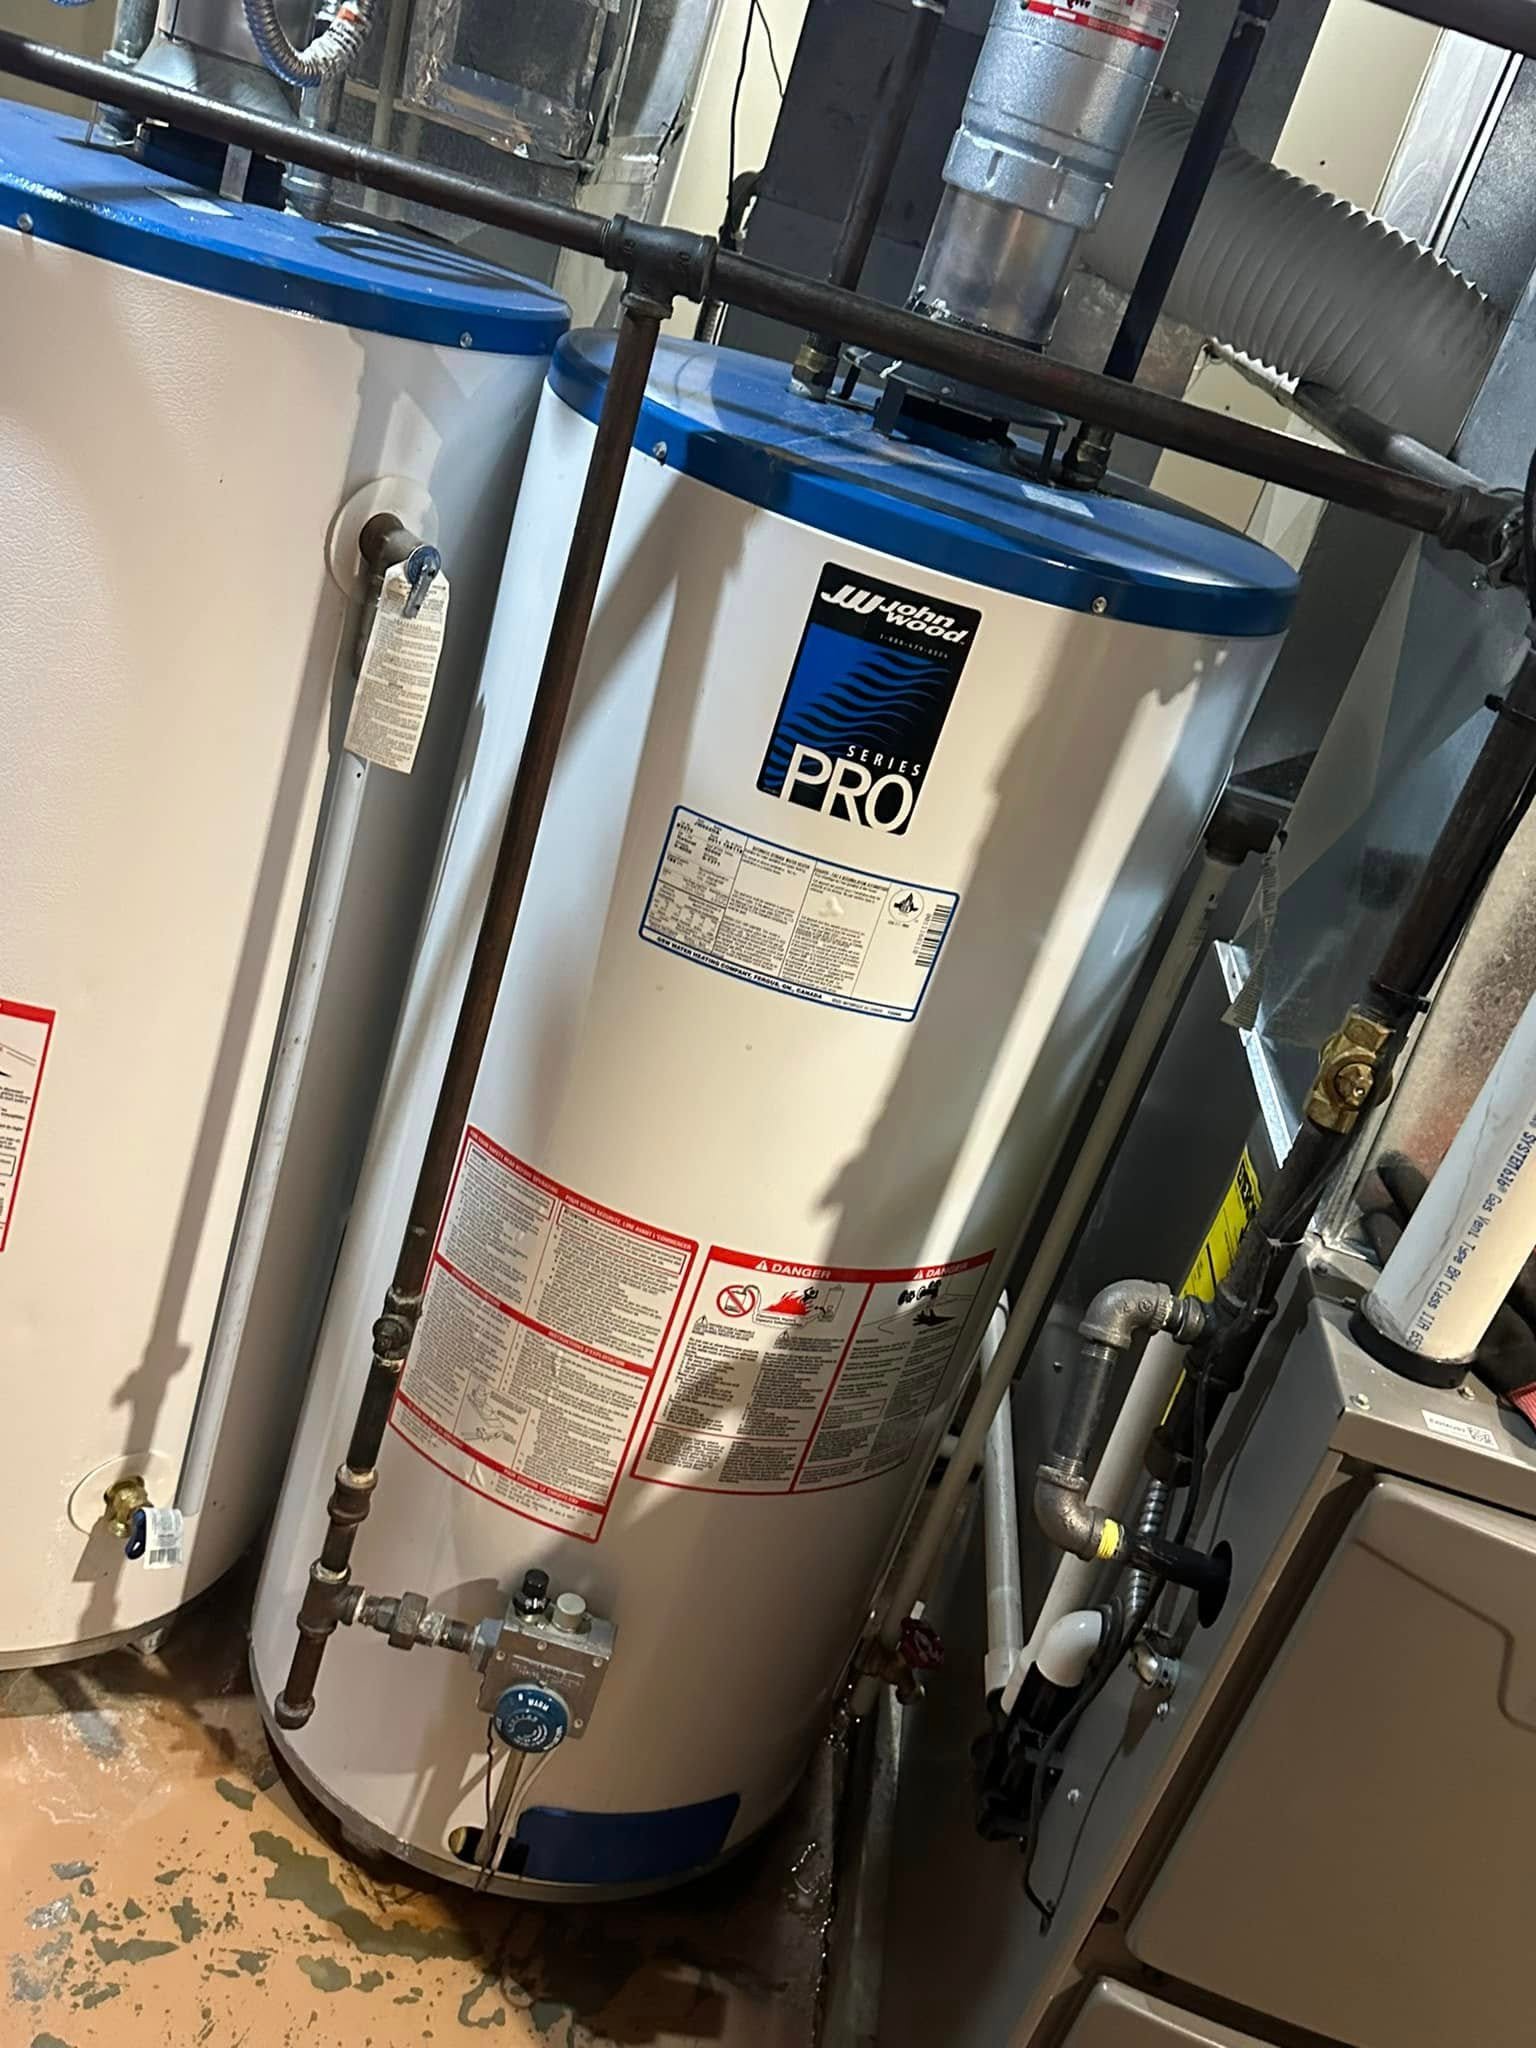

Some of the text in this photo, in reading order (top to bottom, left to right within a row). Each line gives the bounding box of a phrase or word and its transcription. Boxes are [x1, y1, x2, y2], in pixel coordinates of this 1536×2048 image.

[847, 745, 920, 776] SERIES
[780, 743, 914, 833] PRO
[671, 942, 692, 955] WATER
[692, 951, 720, 966] HEATING
[795, 987, 822, 999] CANADA
[1482, 1193, 1502, 1212] Gas
[1467, 1217, 1491, 1239] Vent
[1453, 1245, 1476, 1265] Type
[770, 1262, 831, 1281] DANGER
[1427, 1281, 1453, 1309] Class
